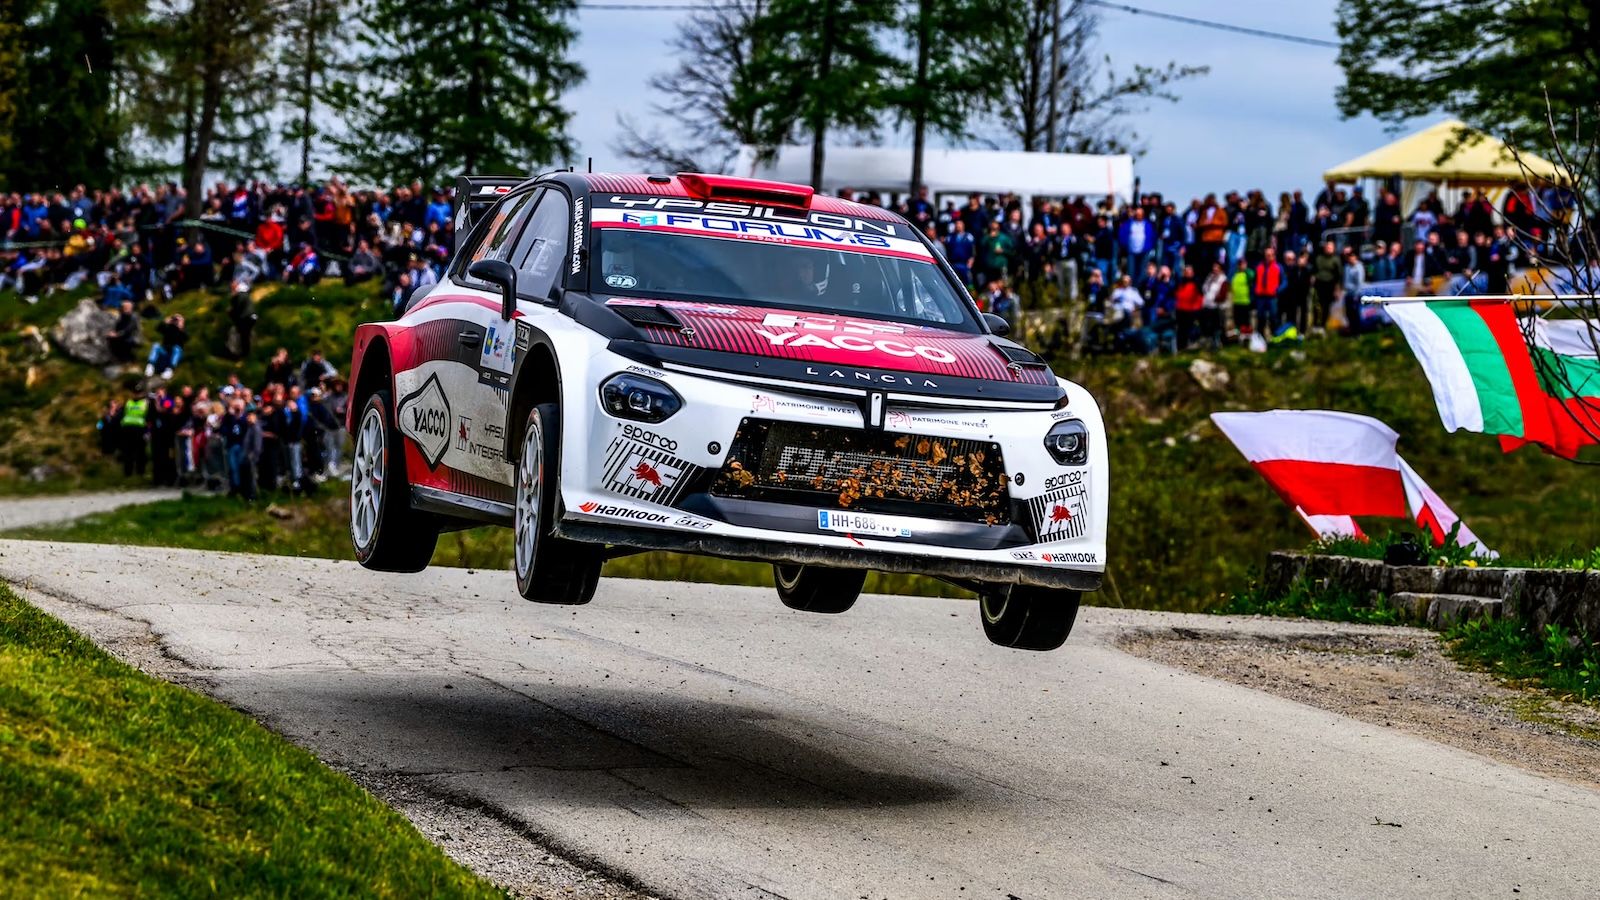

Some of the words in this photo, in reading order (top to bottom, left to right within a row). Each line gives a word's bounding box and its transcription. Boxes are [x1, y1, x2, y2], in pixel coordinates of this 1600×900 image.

[610, 196, 897, 236] YPSILON
[666, 214, 891, 248] FORUM8
[608, 276, 634, 287] FIA
[753, 328, 957, 363] YACCO
[806, 366, 938, 388] LANCIA
[776, 401, 825, 411] PATRIMOINE
[827, 406, 857, 415] INVEST
[413, 406, 446, 438] YACCO
[912, 416, 960, 426] PATRIMOINE
[961, 421, 989, 429] INVEST
[623, 424, 678, 451] sparco
[1044, 470, 1082, 491] sparco
